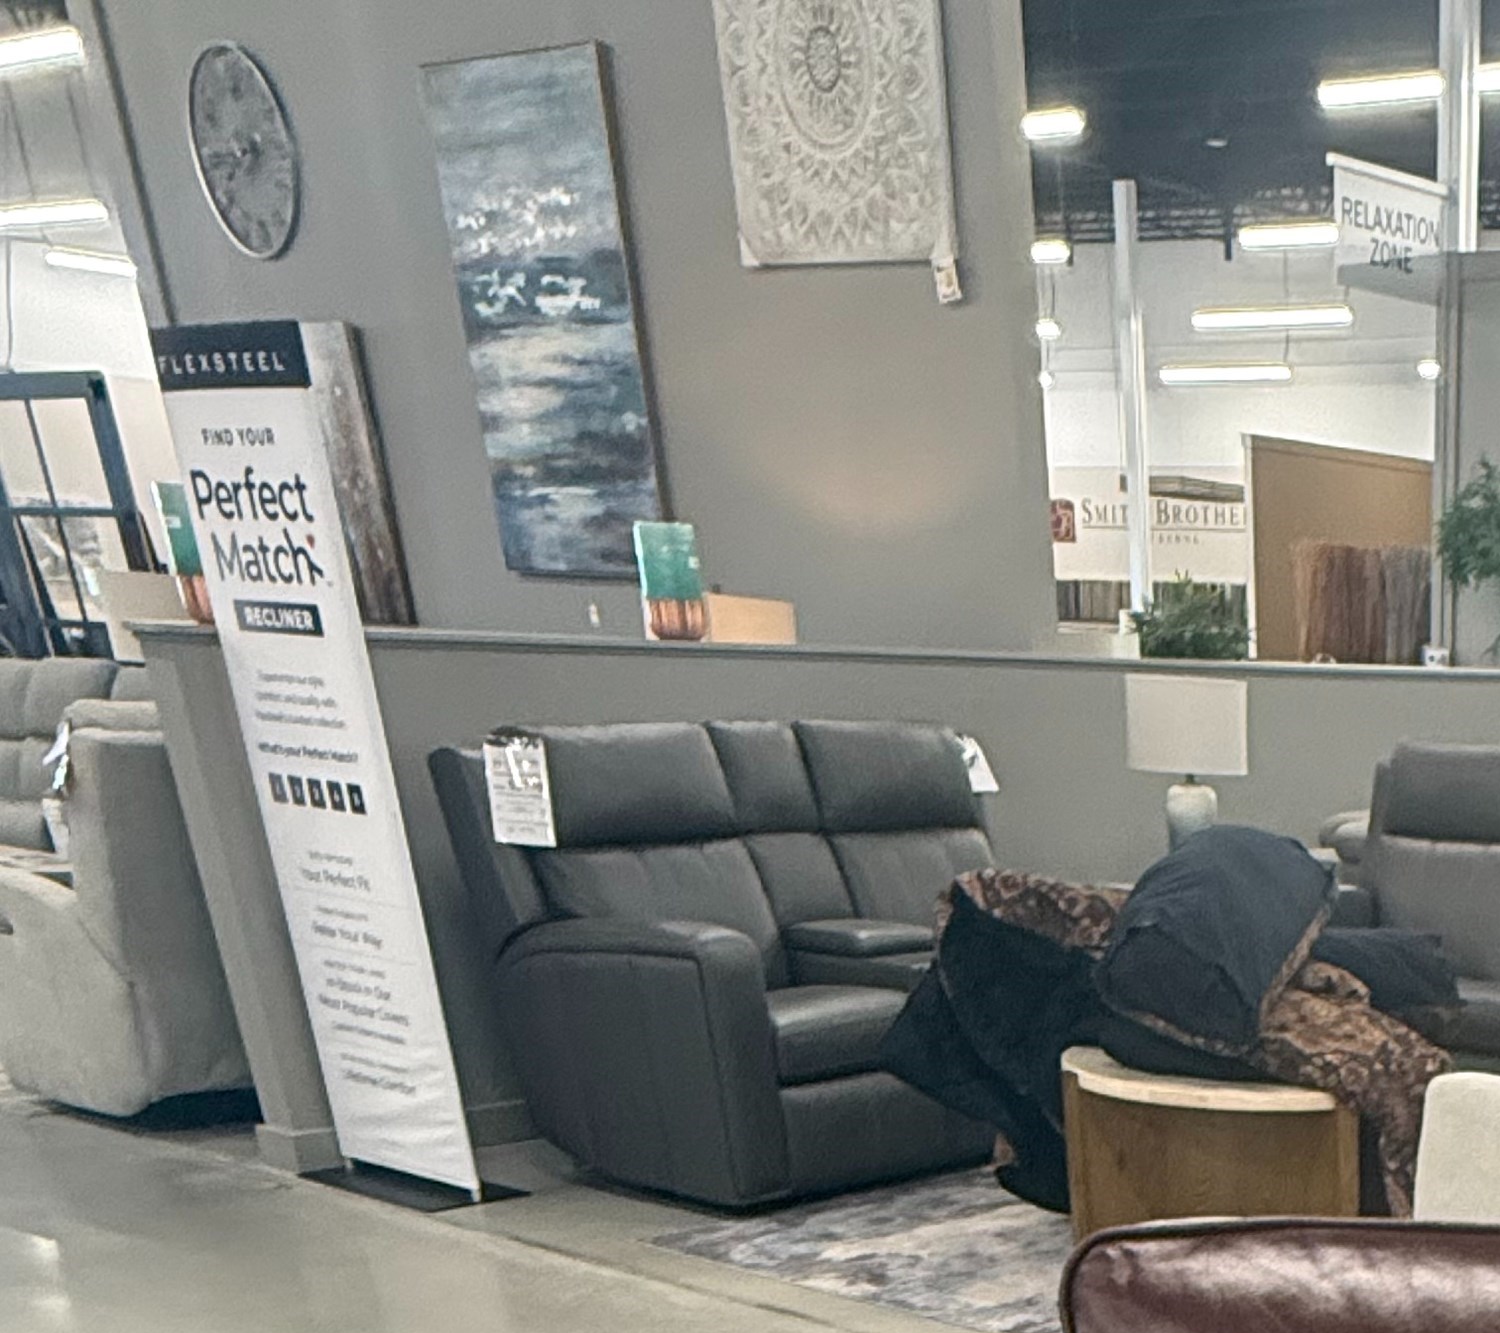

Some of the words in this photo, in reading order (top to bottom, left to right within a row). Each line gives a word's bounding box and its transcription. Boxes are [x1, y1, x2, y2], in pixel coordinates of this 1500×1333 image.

[1341, 196, 1440, 247] RELAXATION
[1370, 237, 1413, 274] ZONE
[158, 350, 285, 375] FLEXSTEEL
[201, 427, 234, 446] FIND
[235, 427, 275, 446] YOUR
[190, 466, 315, 523] Perfect
[1081, 498, 1128, 525] SMIT
[211, 527, 324, 586] Match
[244, 606, 315, 630] RECLINER
